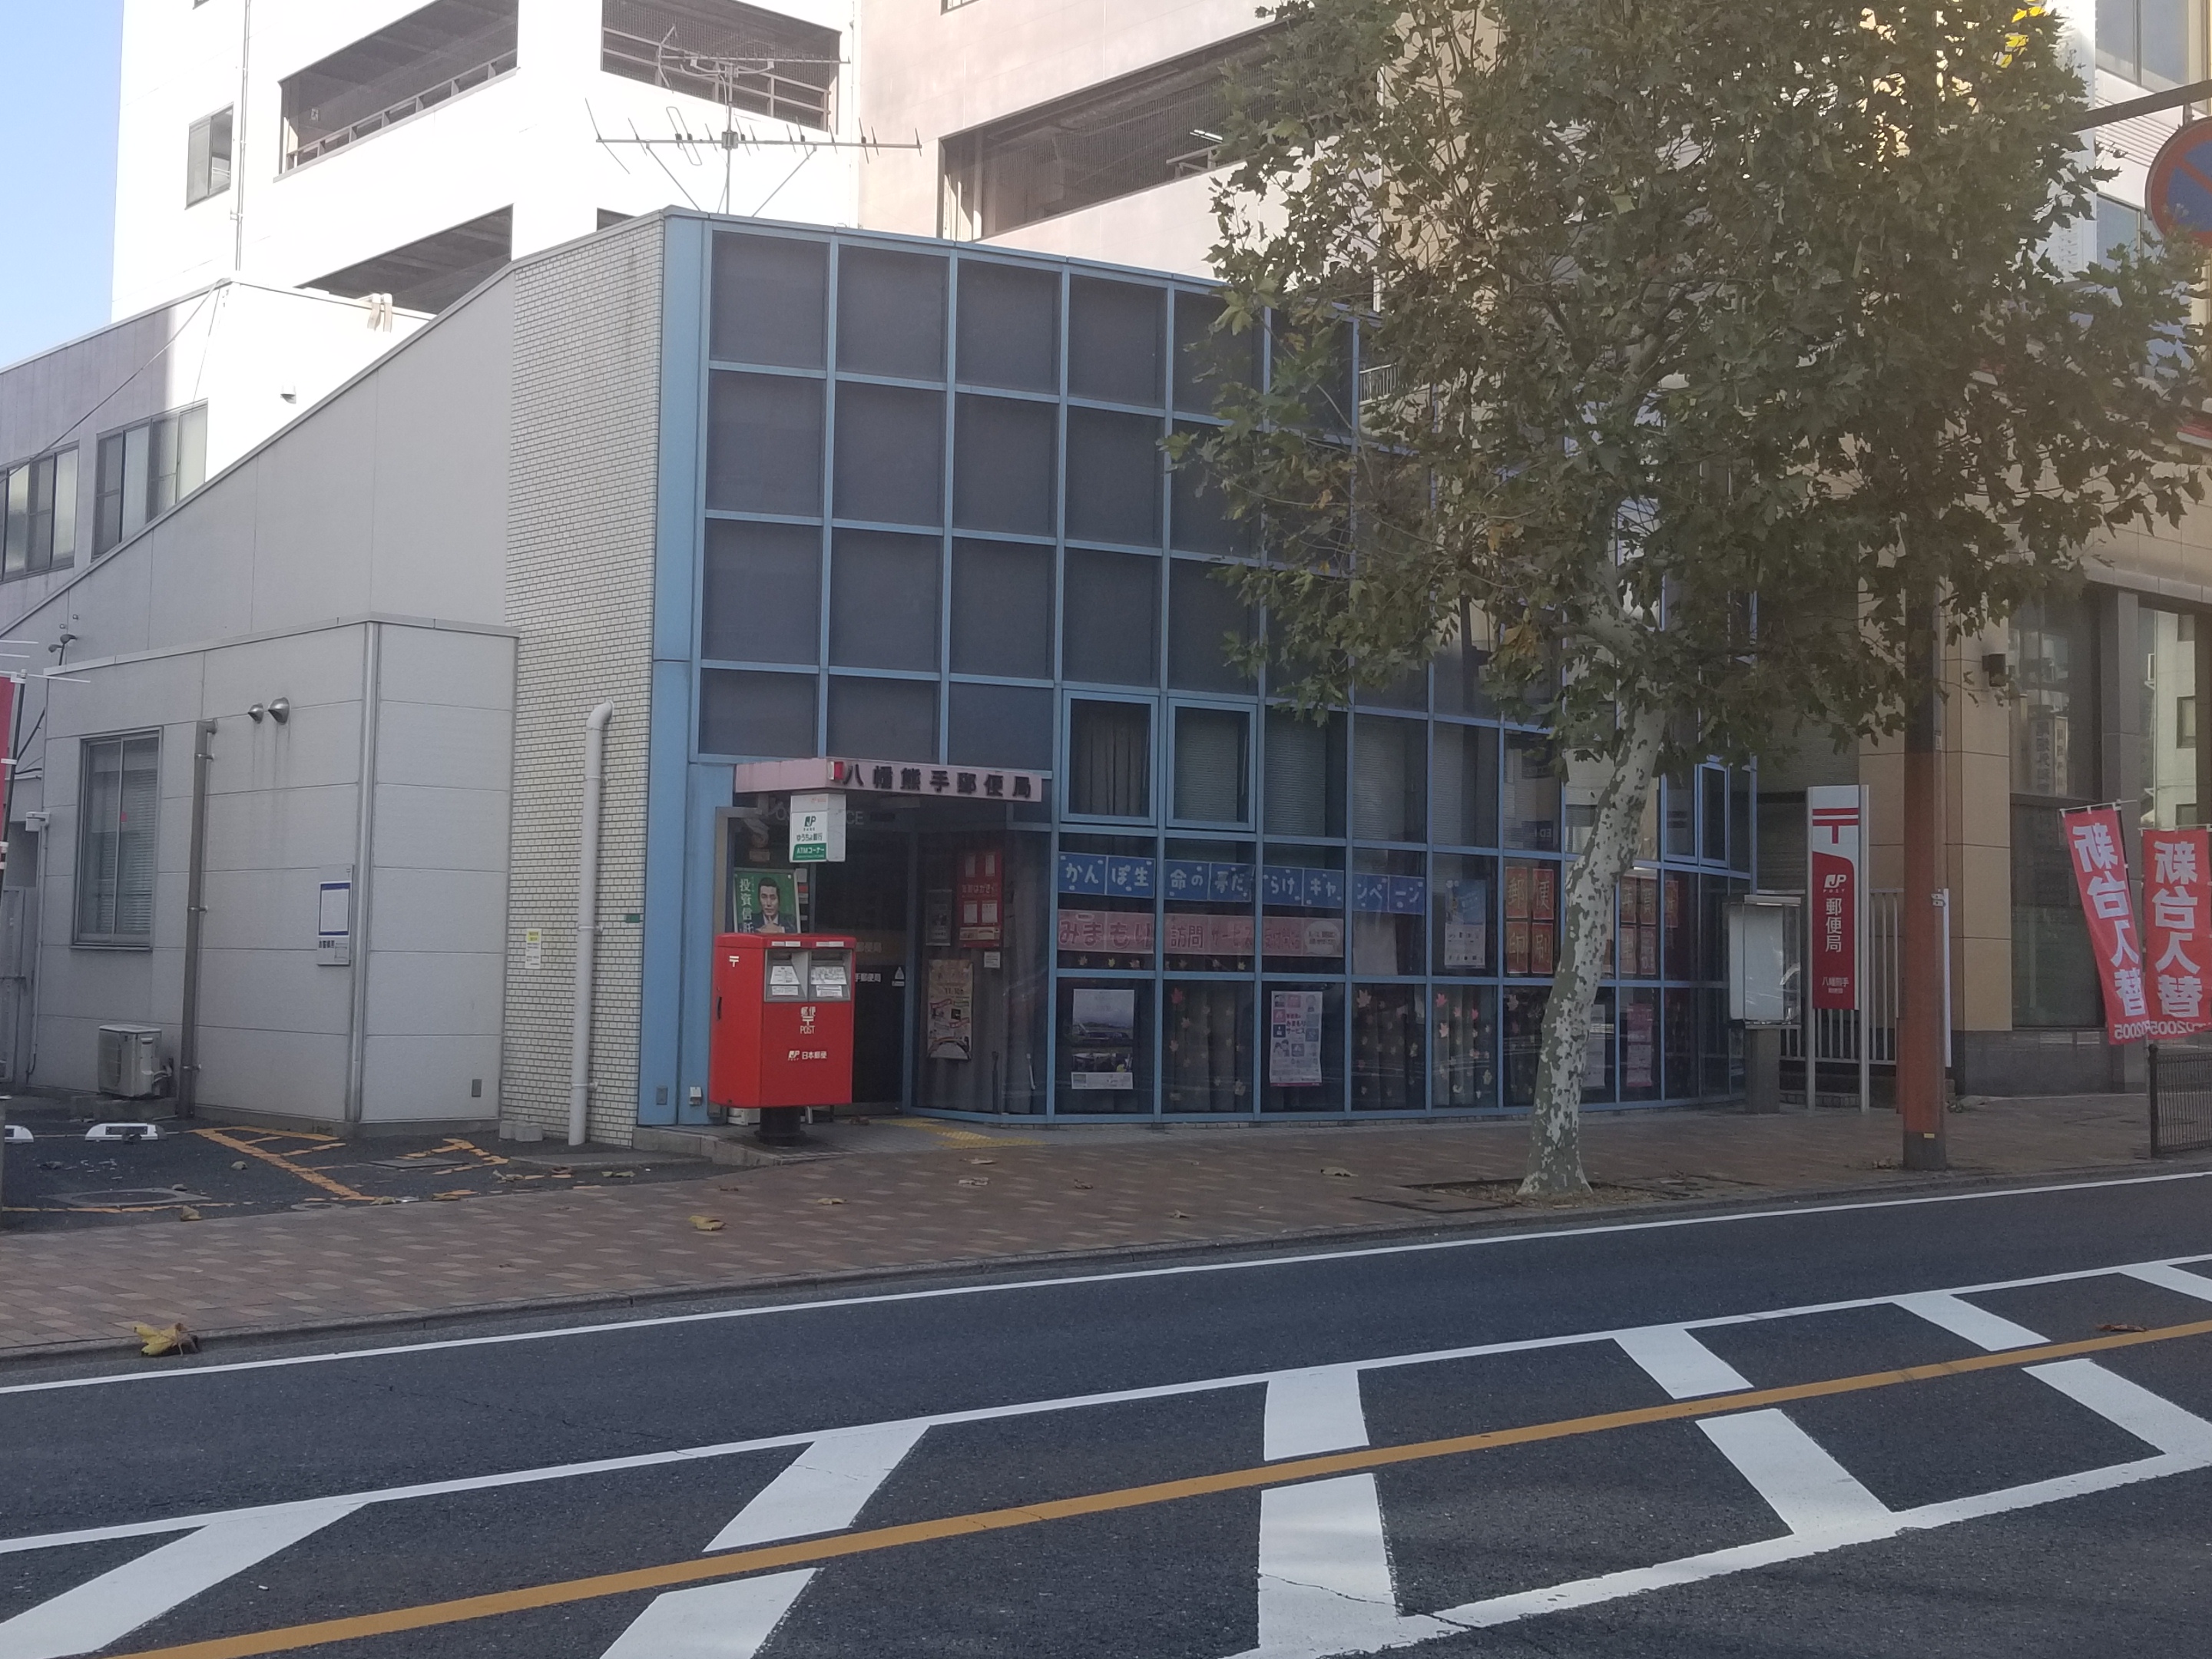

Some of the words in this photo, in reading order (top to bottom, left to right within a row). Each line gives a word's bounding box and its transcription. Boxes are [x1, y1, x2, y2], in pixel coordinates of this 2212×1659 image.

[843, 763, 1031, 799] 八幡熊手郵便局
[740, 878, 754, 933] 投資信託
[1825, 898, 1843, 953] 郵便局
[800, 1025, 816, 1035] POST
[802, 1051, 828, 1060] 日本郵便
